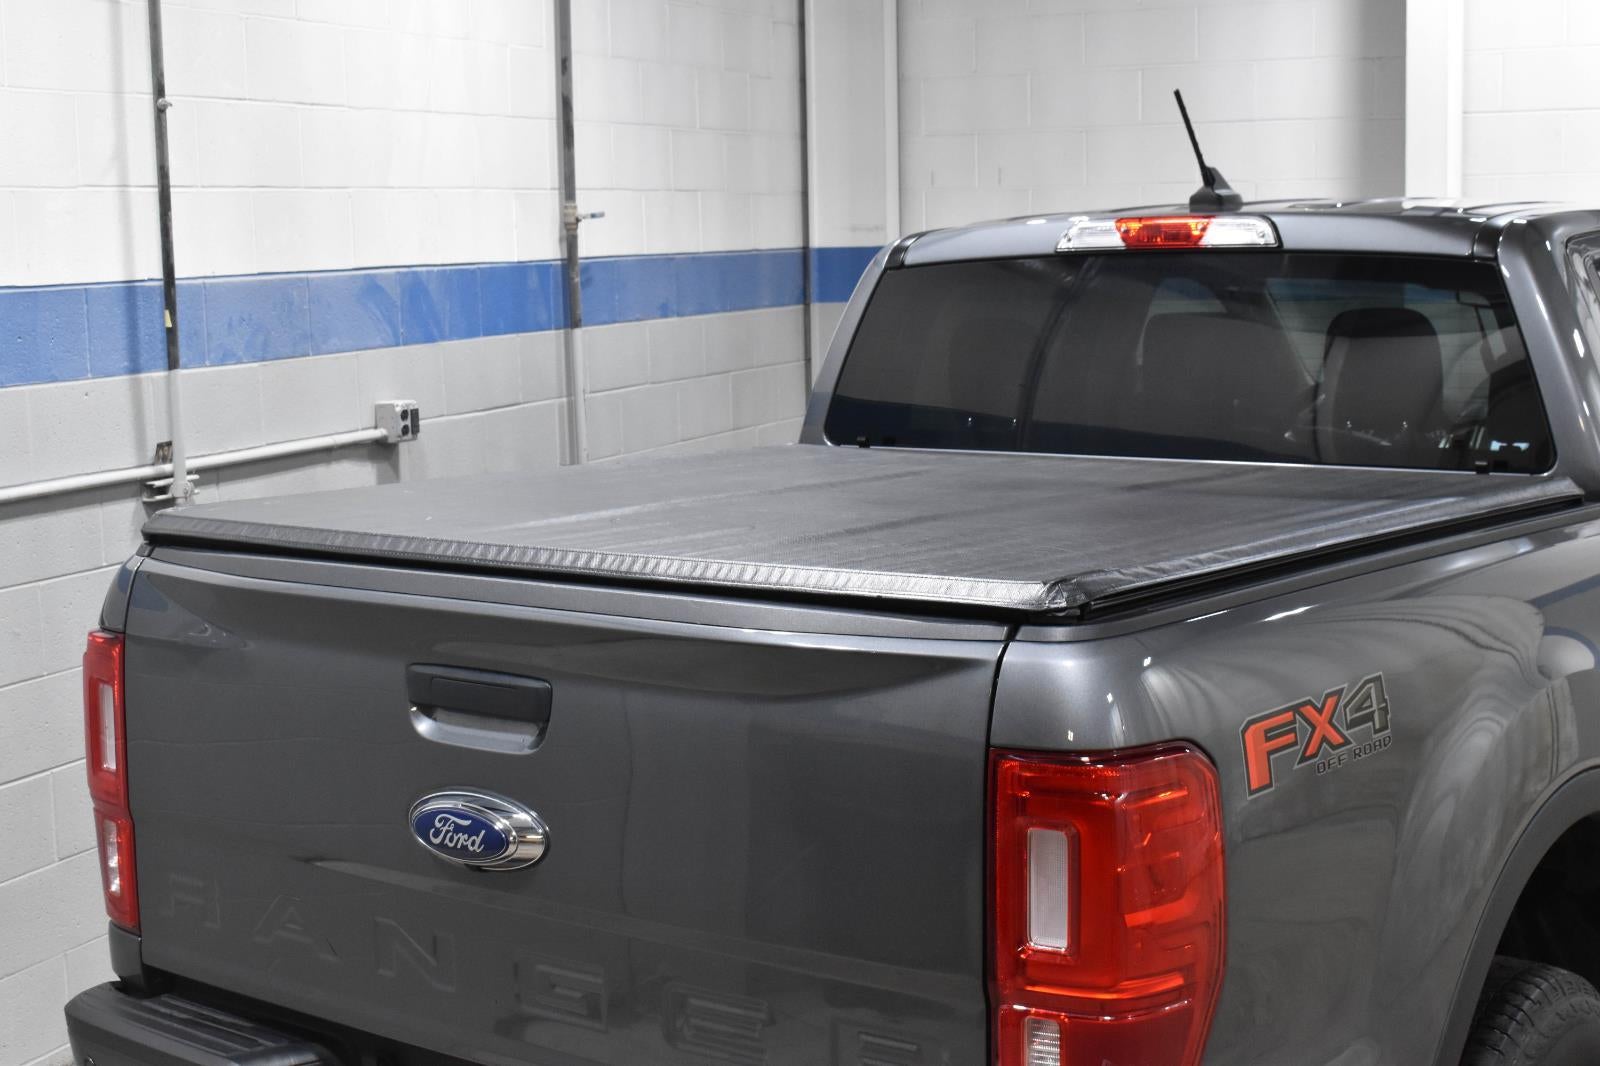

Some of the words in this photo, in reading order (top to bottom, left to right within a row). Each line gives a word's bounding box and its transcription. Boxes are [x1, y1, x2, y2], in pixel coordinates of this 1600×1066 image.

[1240, 672, 1391, 799] FX4
[1315, 754, 1347, 775] OFF
[1353, 735, 1392, 761] ROAD
[429, 813, 485, 853] Ford
